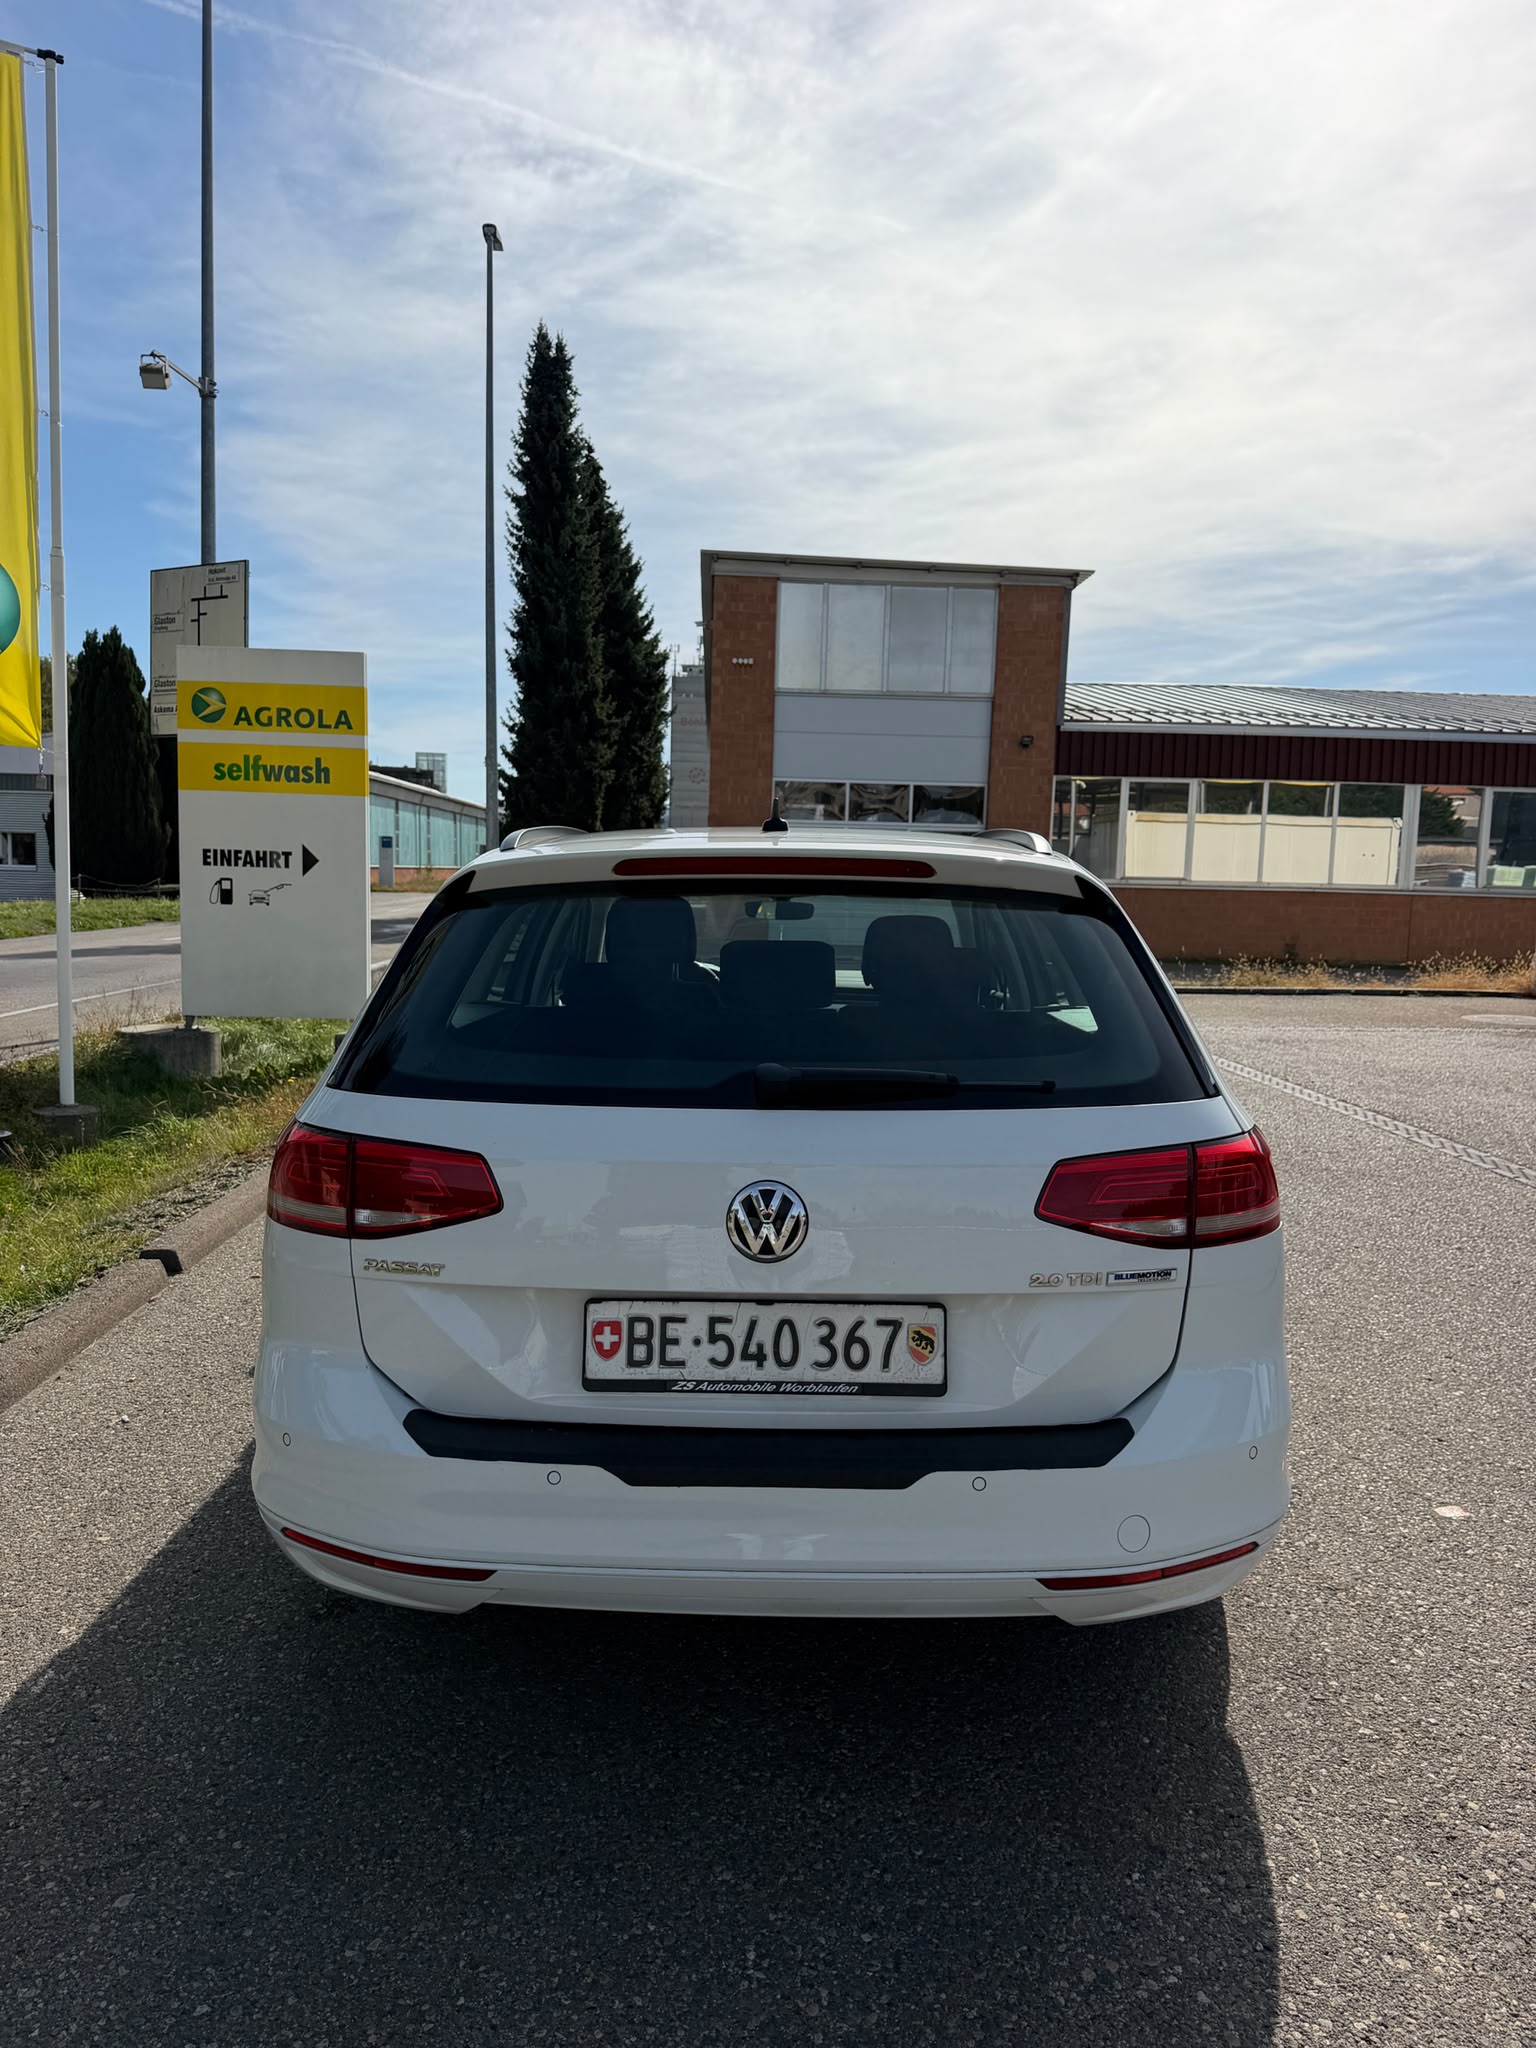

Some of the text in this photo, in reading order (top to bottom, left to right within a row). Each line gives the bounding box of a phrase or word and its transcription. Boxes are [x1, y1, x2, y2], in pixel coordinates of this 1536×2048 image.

[154, 616, 176, 625] Glaston
[154, 679, 176, 688] Glaston
[233, 706, 354, 730] AGROLA
[213, 754, 331, 784] selfwash
[202, 848, 293, 869] EINFAHRT
[363, 1258, 446, 1277] PASSAT
[1114, 1270, 1172, 1281] BLUEMOTION
[1029, 1271, 1103, 1288] 2.0 TDI
[672, 1381, 860, 1394] ZS Automobile Worblaufen
